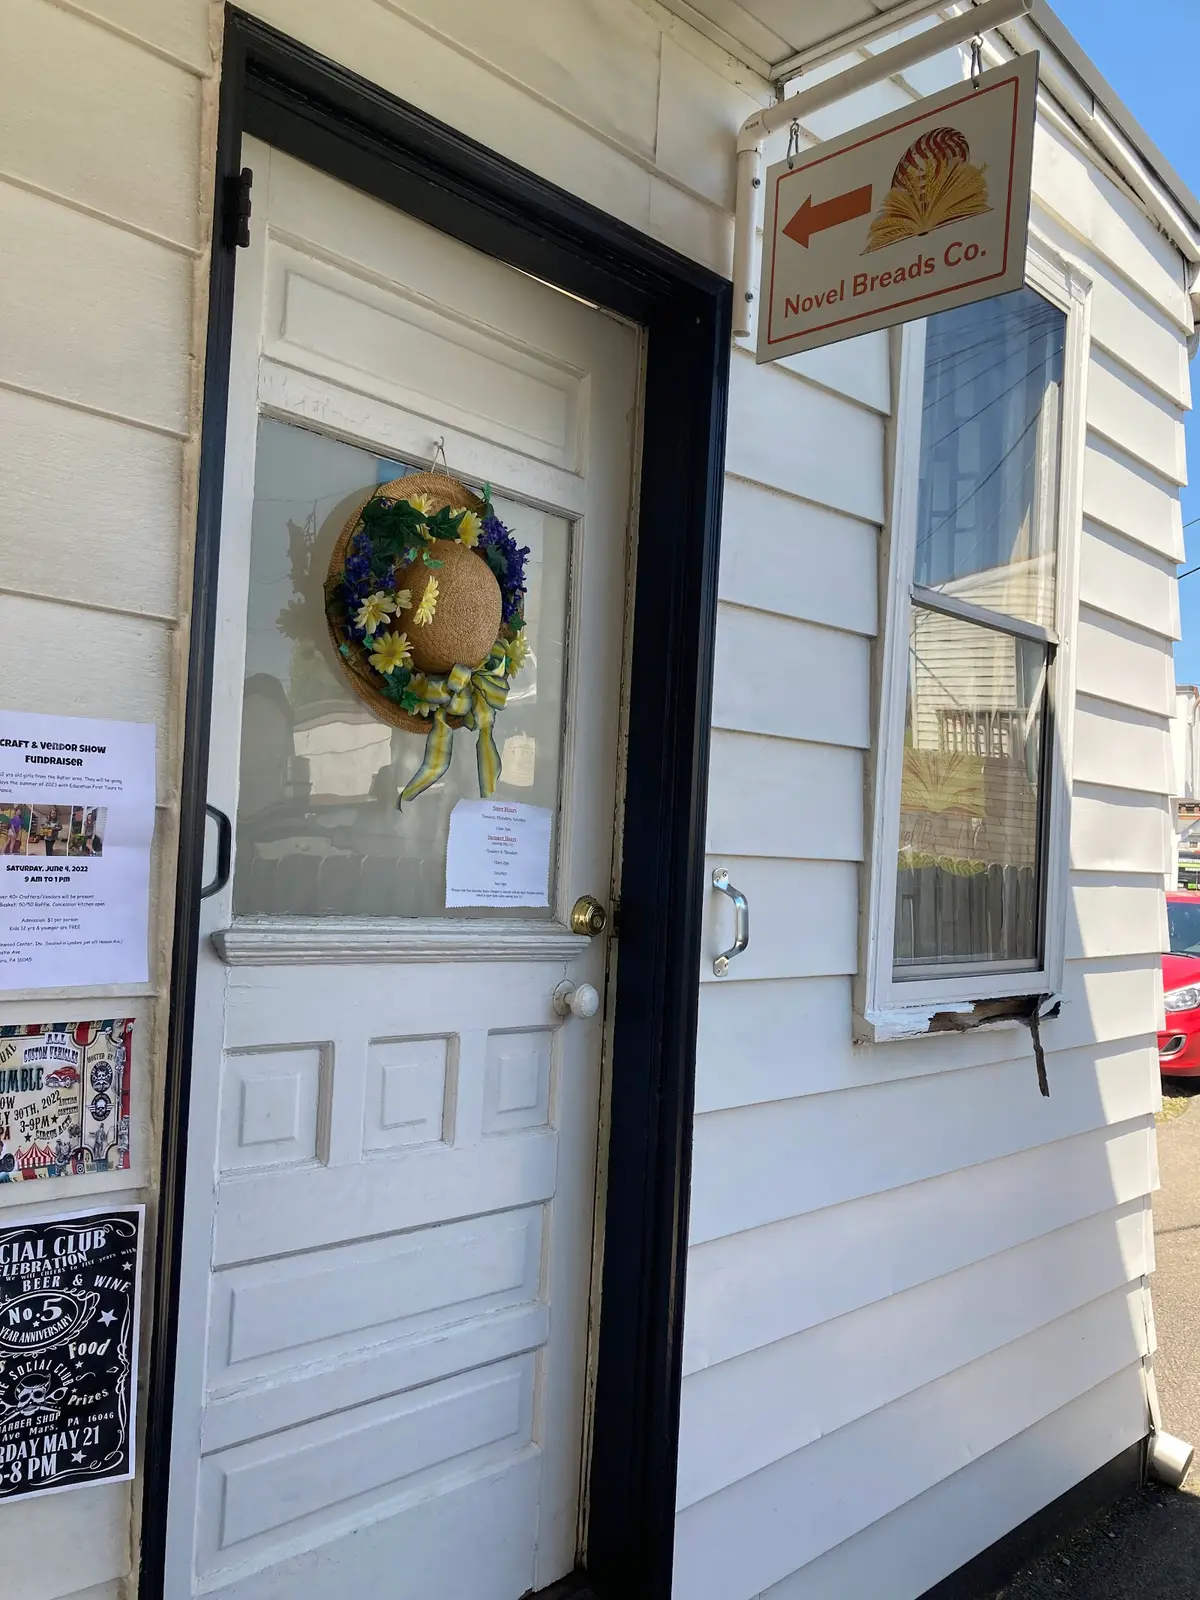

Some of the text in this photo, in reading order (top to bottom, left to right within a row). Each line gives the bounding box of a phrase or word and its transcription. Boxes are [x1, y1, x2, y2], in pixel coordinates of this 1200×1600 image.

[784, 241, 987, 318] Novel Breads Co.
[0, 739, 29, 749] CRAFT
[31, 741, 38, 749] &
[79, 744, 106, 754] SHOW
[46, 1033, 67, 1045] ALL
[24, 1046, 79, 1065] CUSTOM VEHICLES
[41, 1090, 61, 1109] 2022
[20, 1115, 50, 1133] 3-9PM
[53, 1230, 107, 1257] CLUB
[120, 1247, 137, 1255] with
[22, 1275, 61, 1293] BEER
[93, 1274, 132, 1293] WINE
[0, 1313, 74, 1344] YEAR ANNIVERSARY
[68, 1338, 112, 1360] Food
[9, 1359, 53, 1381] SOCIAL
[53, 1363, 75, 1387] CLUB
[67, 1388, 109, 1406] Prizes
[2, 1431, 20, 1443] Ave
[67, 1417, 80, 1427] PA
[88, 1411, 115, 1423] 16046
[36, 1411, 61, 1425] SHOP
[43, 1429, 80, 1454] MAY
[83, 1425, 100, 1446] 21
[28, 1453, 57, 1480] PM
